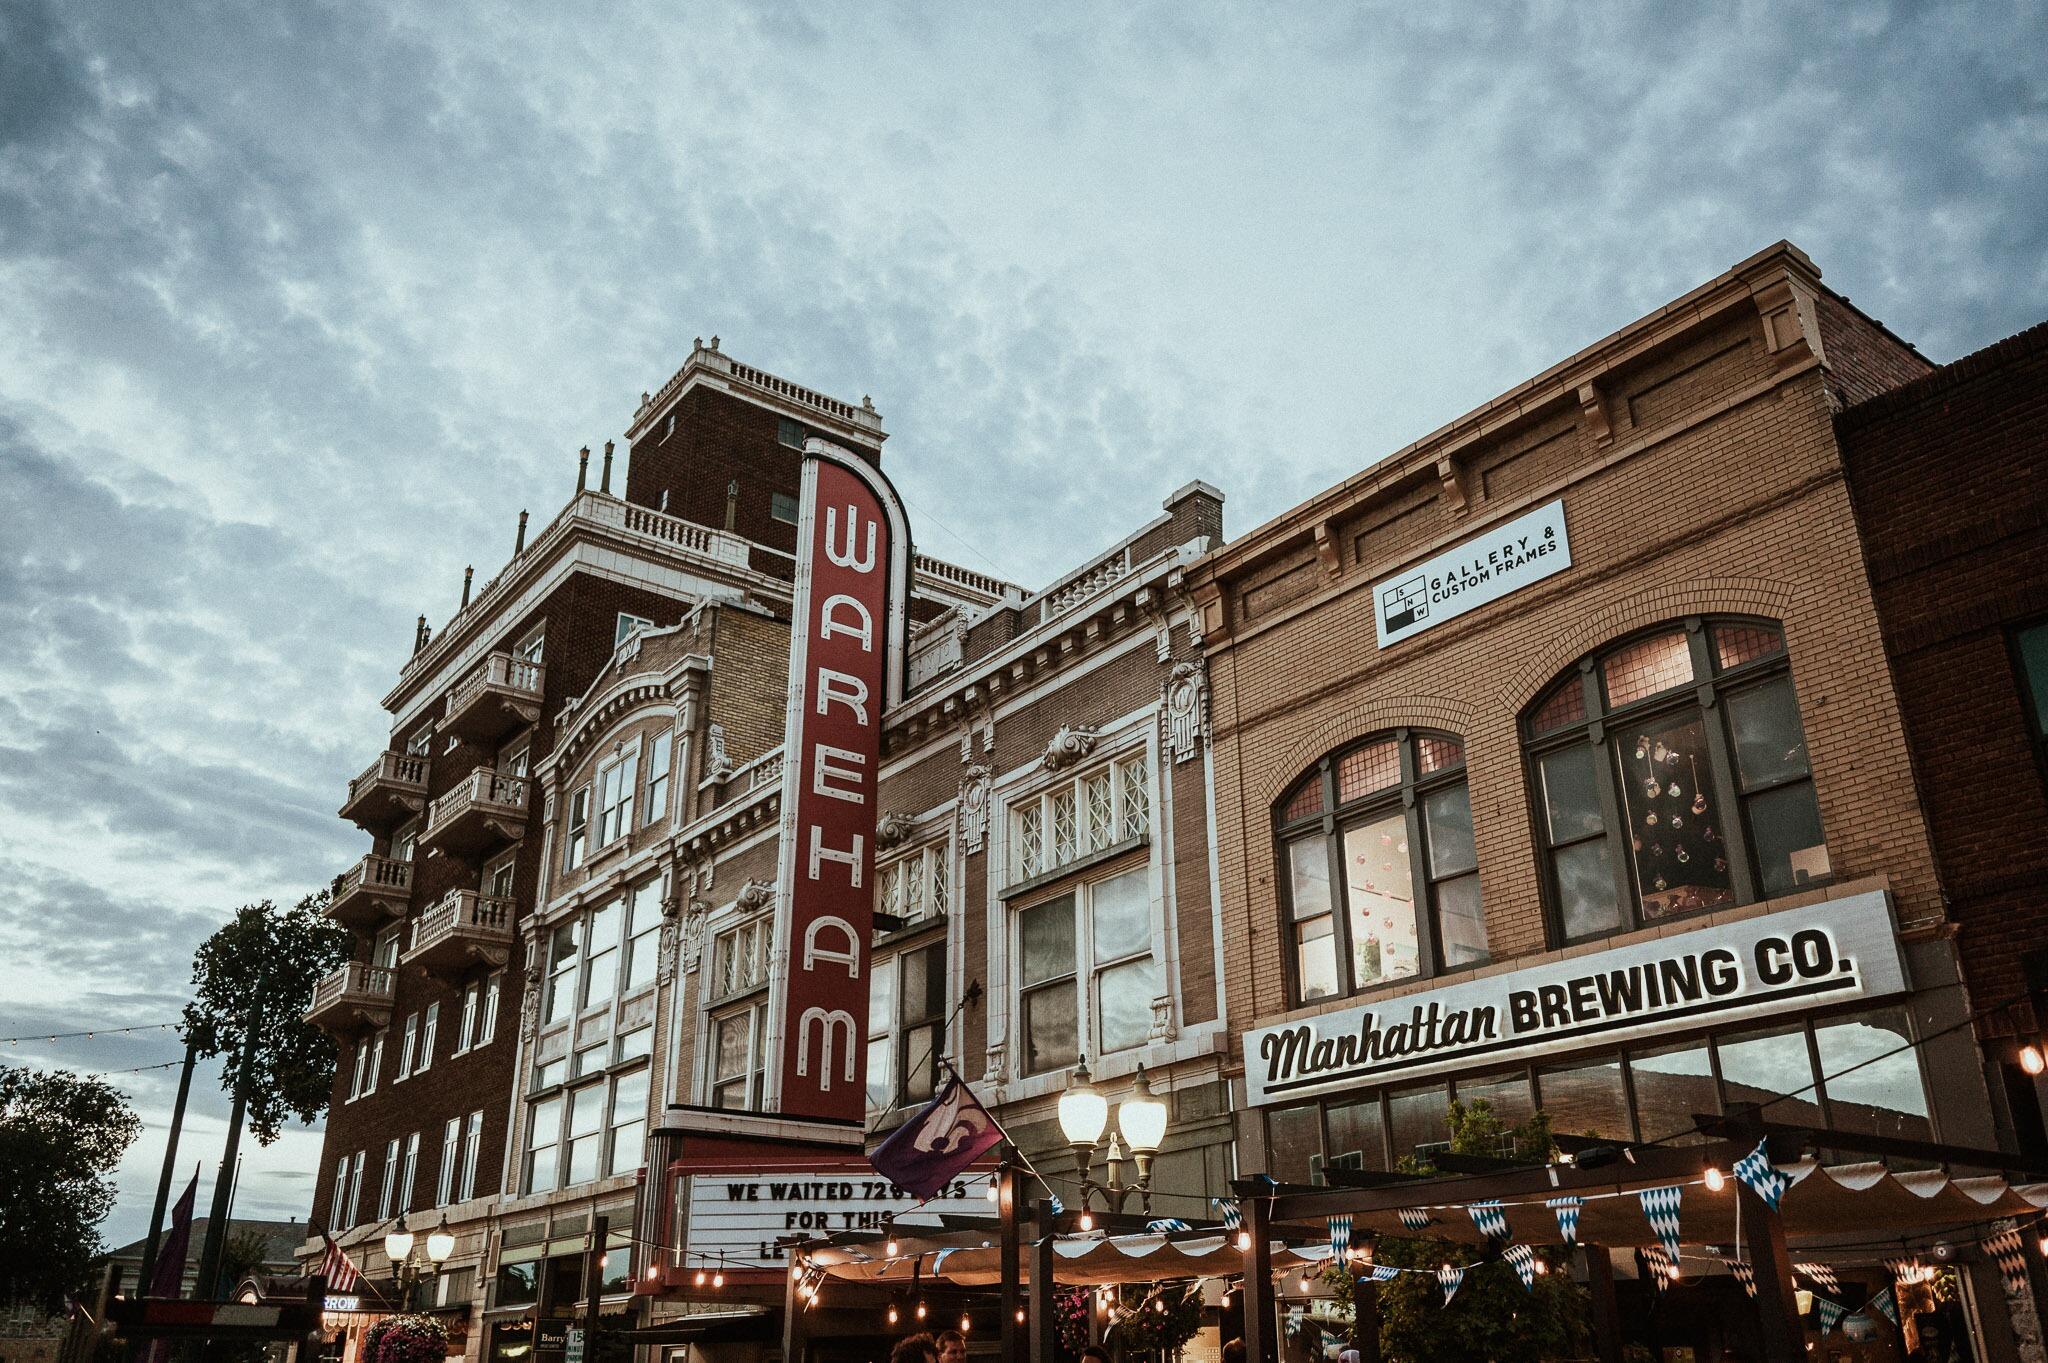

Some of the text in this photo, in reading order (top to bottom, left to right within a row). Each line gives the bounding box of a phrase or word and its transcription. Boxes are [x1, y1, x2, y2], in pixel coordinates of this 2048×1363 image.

[1431, 526, 1555, 591] GALLERY &
[1432, 540, 1557, 604] CUSTOM FRAMES
[1416, 608, 1425, 616] W
[796, 503, 877, 1092] WAREHAM
[1261, 929, 1852, 1081] Manhattan BREWING CO.
[728, 1181, 966, 1201] WE WAITED 728 YS
[785, 1210, 894, 1229] FOR THIS
[760, 1241, 785, 1259] LE
[324, 1297, 359, 1310] RROW
[574, 1332, 583, 1342] 15
